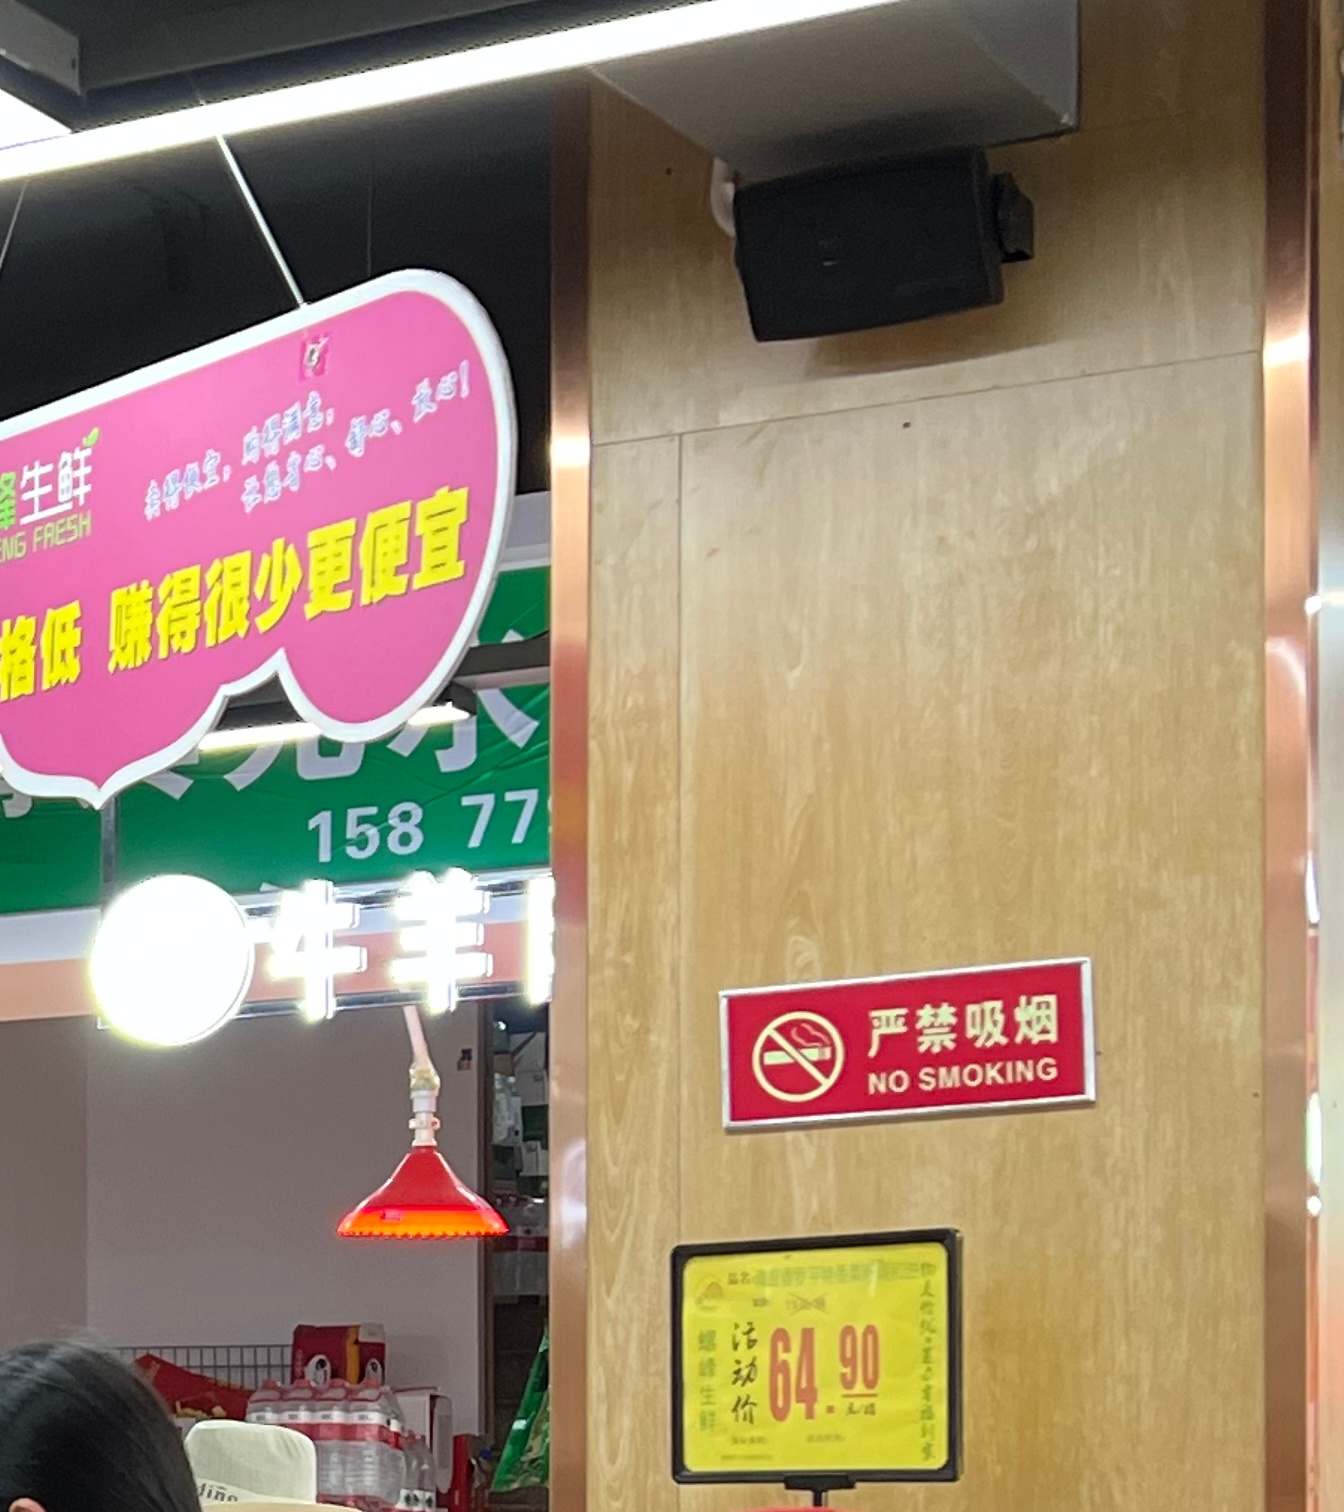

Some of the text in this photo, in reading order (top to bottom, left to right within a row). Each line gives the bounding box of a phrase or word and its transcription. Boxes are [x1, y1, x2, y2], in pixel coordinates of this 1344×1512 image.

[32, 509, 93, 553] FRESH
[108, 486, 471, 675] 赚得很少更便宜
[307, 788, 551, 863] 158 77
[867, 994, 1059, 1058] 严禁吸烟
[868, 1056, 1059, 1095] NO SMOKING
[731, 1322, 758, 1426] 活动价
